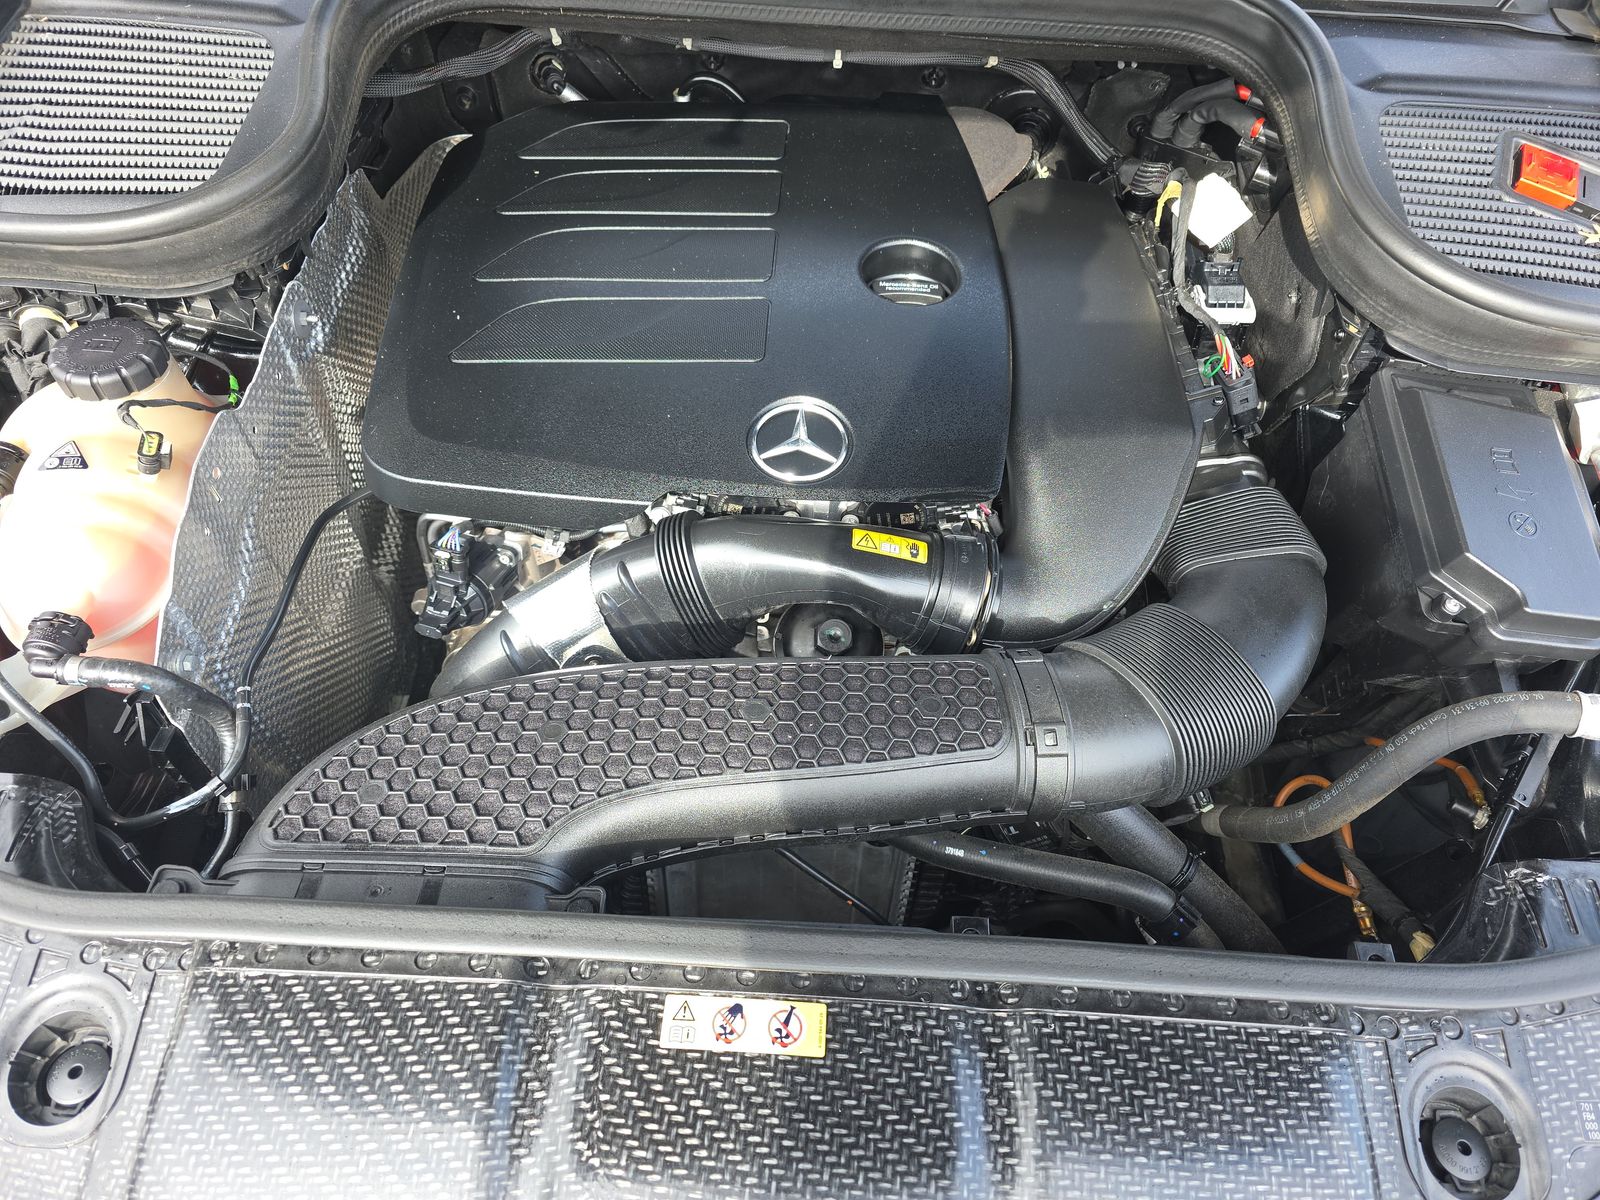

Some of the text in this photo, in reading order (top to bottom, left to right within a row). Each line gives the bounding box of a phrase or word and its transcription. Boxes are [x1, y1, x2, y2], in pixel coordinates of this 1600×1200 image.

[879, 281, 928, 289] Mercedes-Benz
[1408, 712, 1447, 736] ContiTech
[1580, 1102, 1593, 1111] 701
[1584, 1121, 1599, 1131] 000
